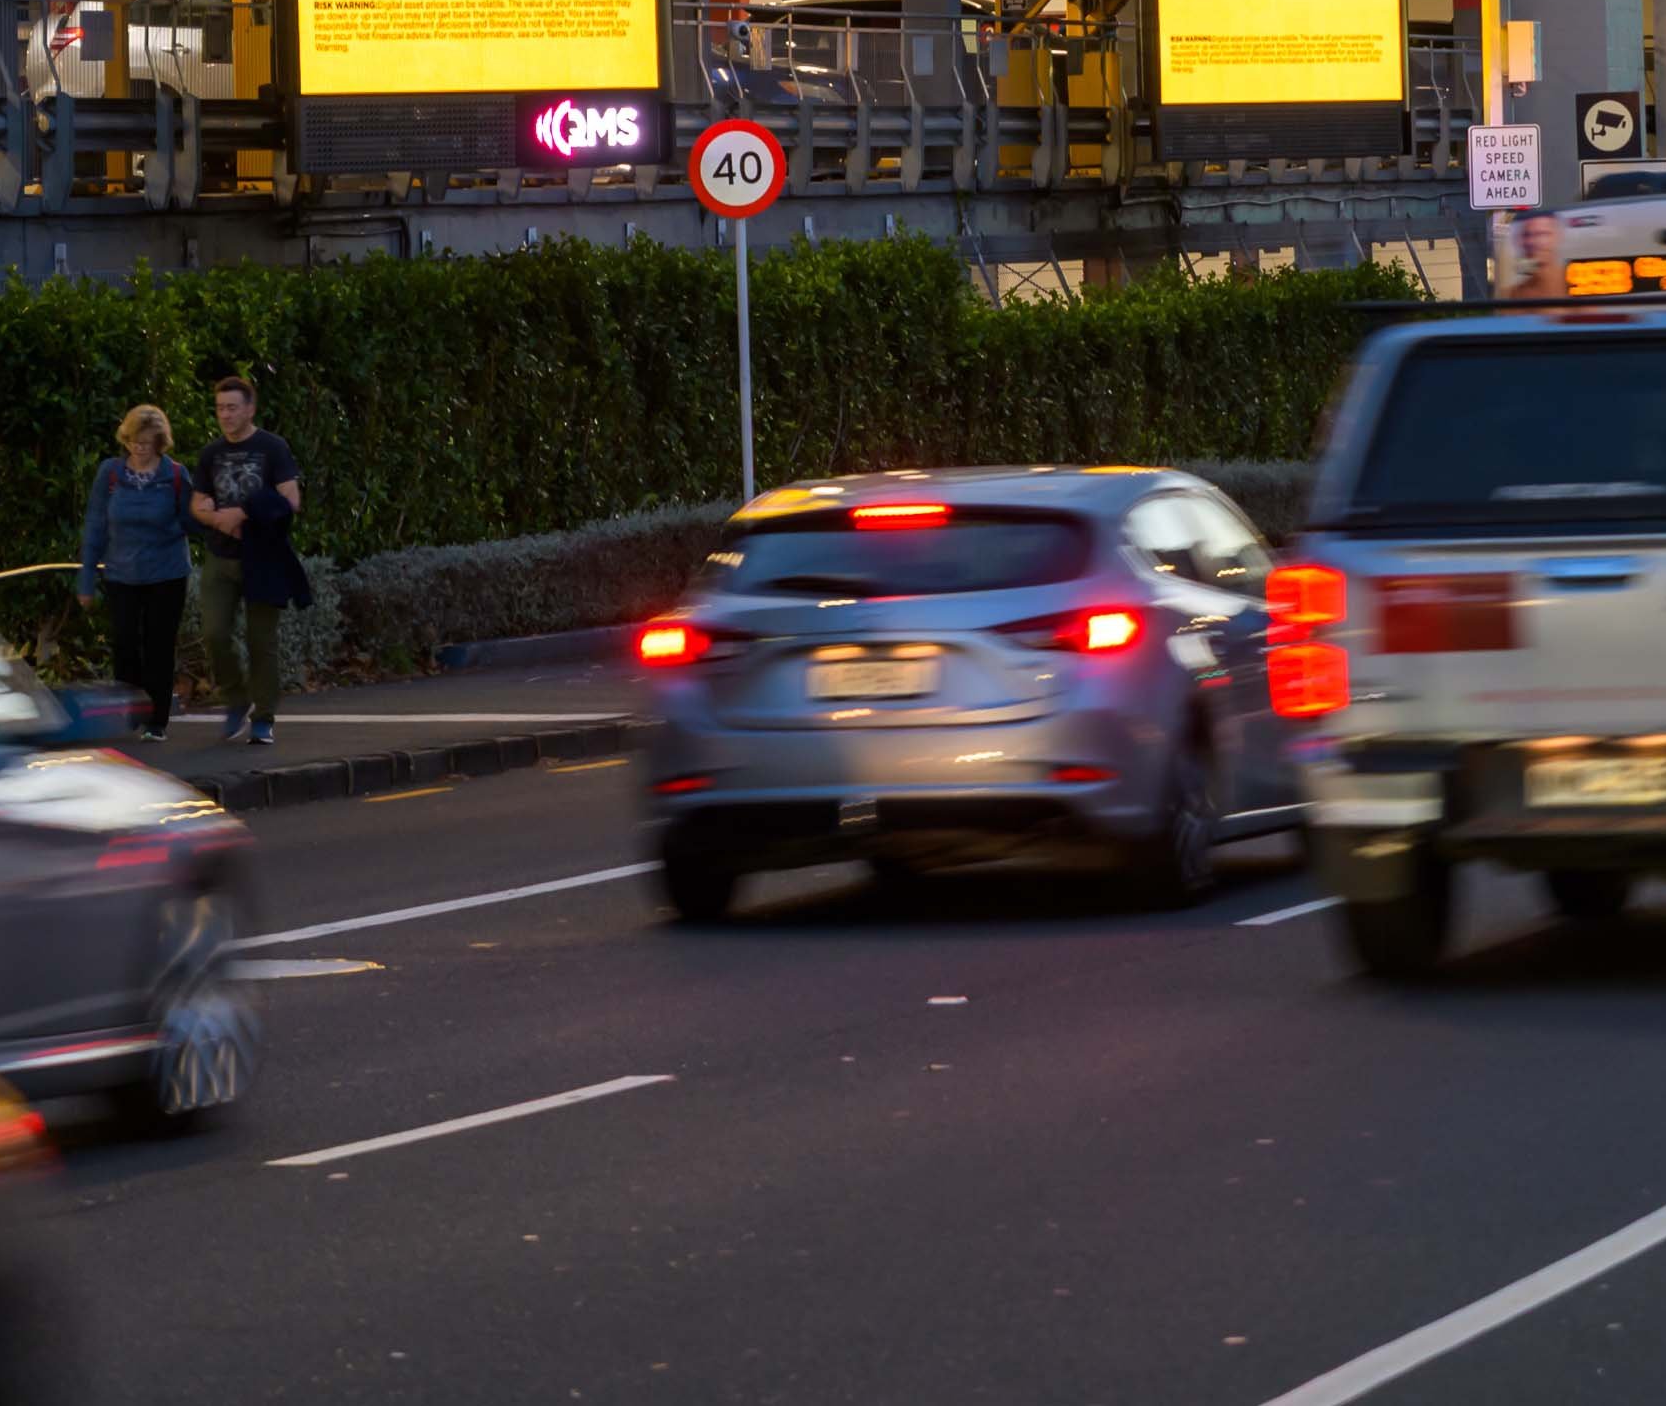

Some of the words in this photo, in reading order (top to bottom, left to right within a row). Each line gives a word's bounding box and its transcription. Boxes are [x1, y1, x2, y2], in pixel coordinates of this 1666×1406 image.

[314, 2, 332, 10] RISK
[1475, 135, 1497, 148] RED
[1501, 134, 1534, 147] LIGHT
[1485, 152, 1525, 165] SPEED
[712, 151, 763, 185] 40
[1480, 169, 1531, 182] CAMERA
[1485, 186, 1527, 199] AHEAD
